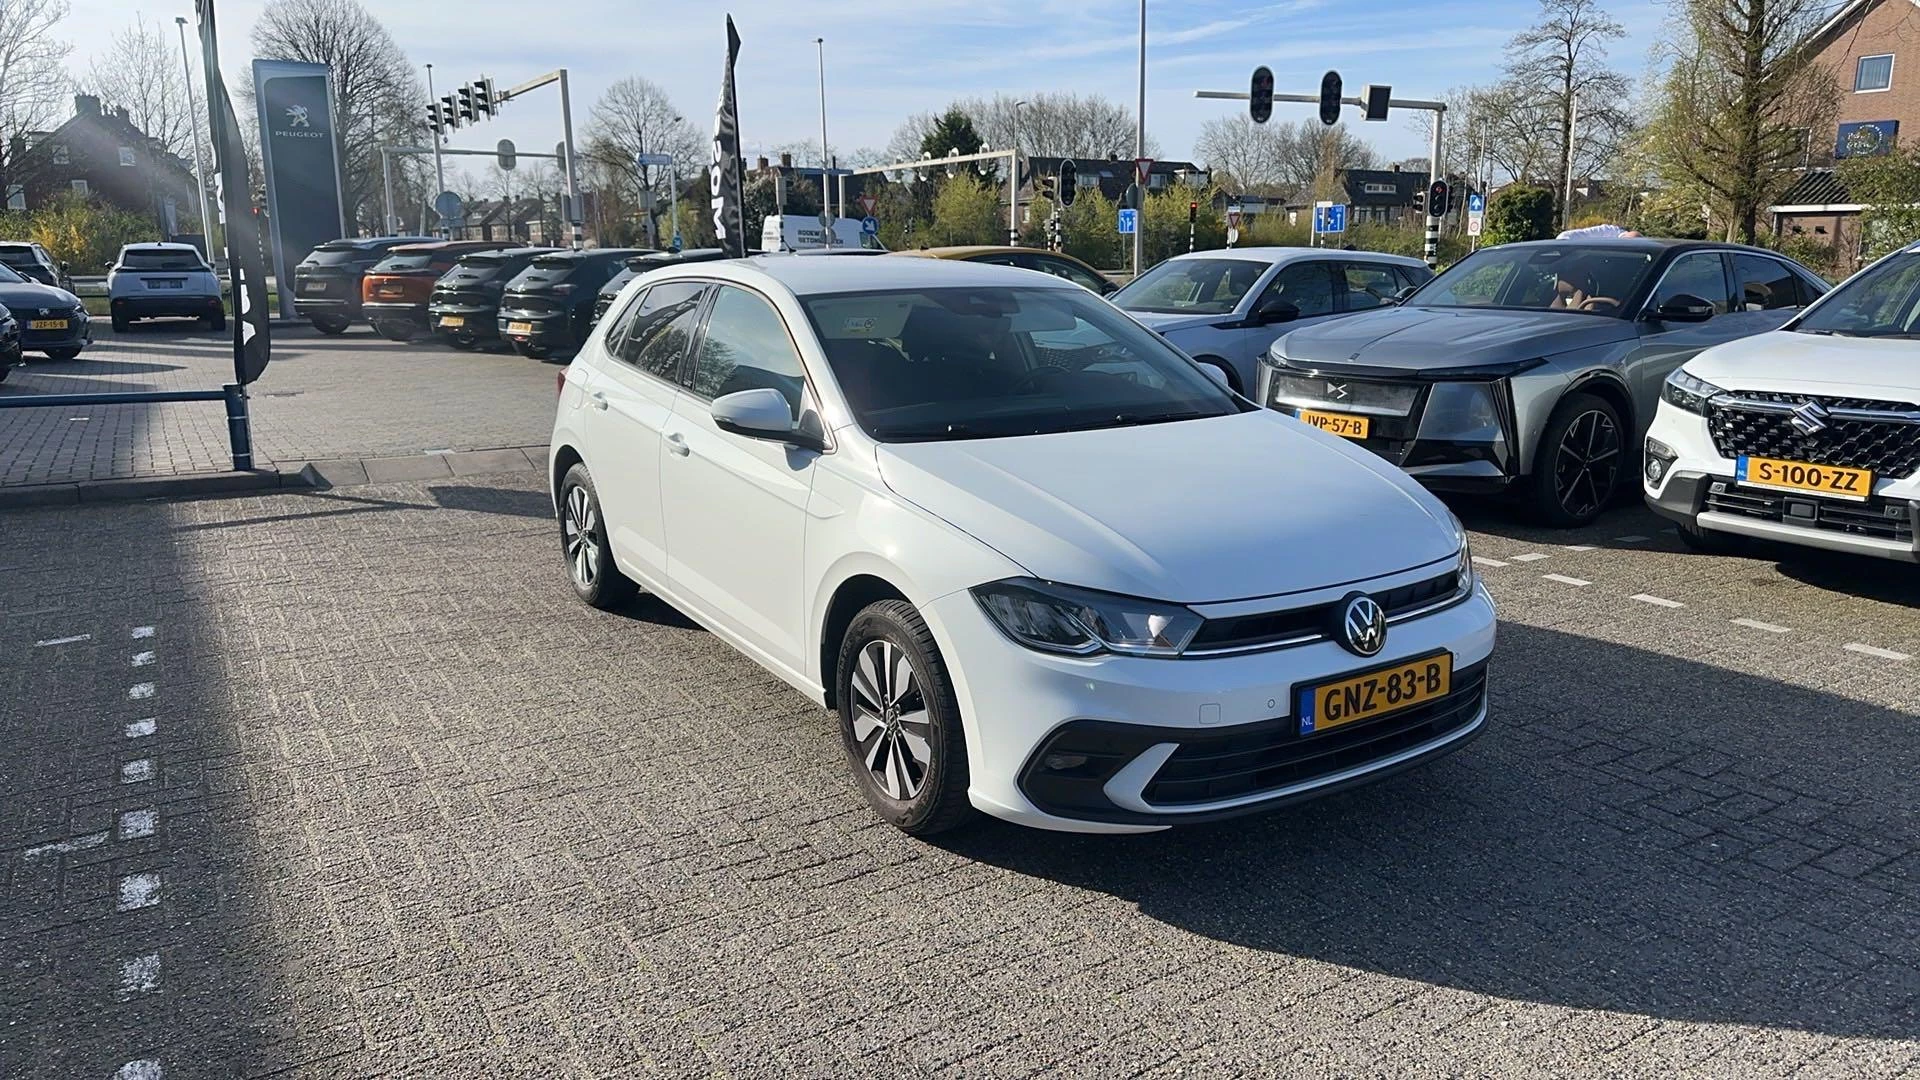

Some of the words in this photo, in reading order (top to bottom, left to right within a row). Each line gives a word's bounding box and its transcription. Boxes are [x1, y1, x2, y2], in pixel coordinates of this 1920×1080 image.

[275, 130, 325, 138] PEUGEOT
[1759, 462, 1860, 492] S-100-ZZ
[1324, 662, 1442, 722] GNZ-83-B
[1301, 715, 1313, 727] NL
